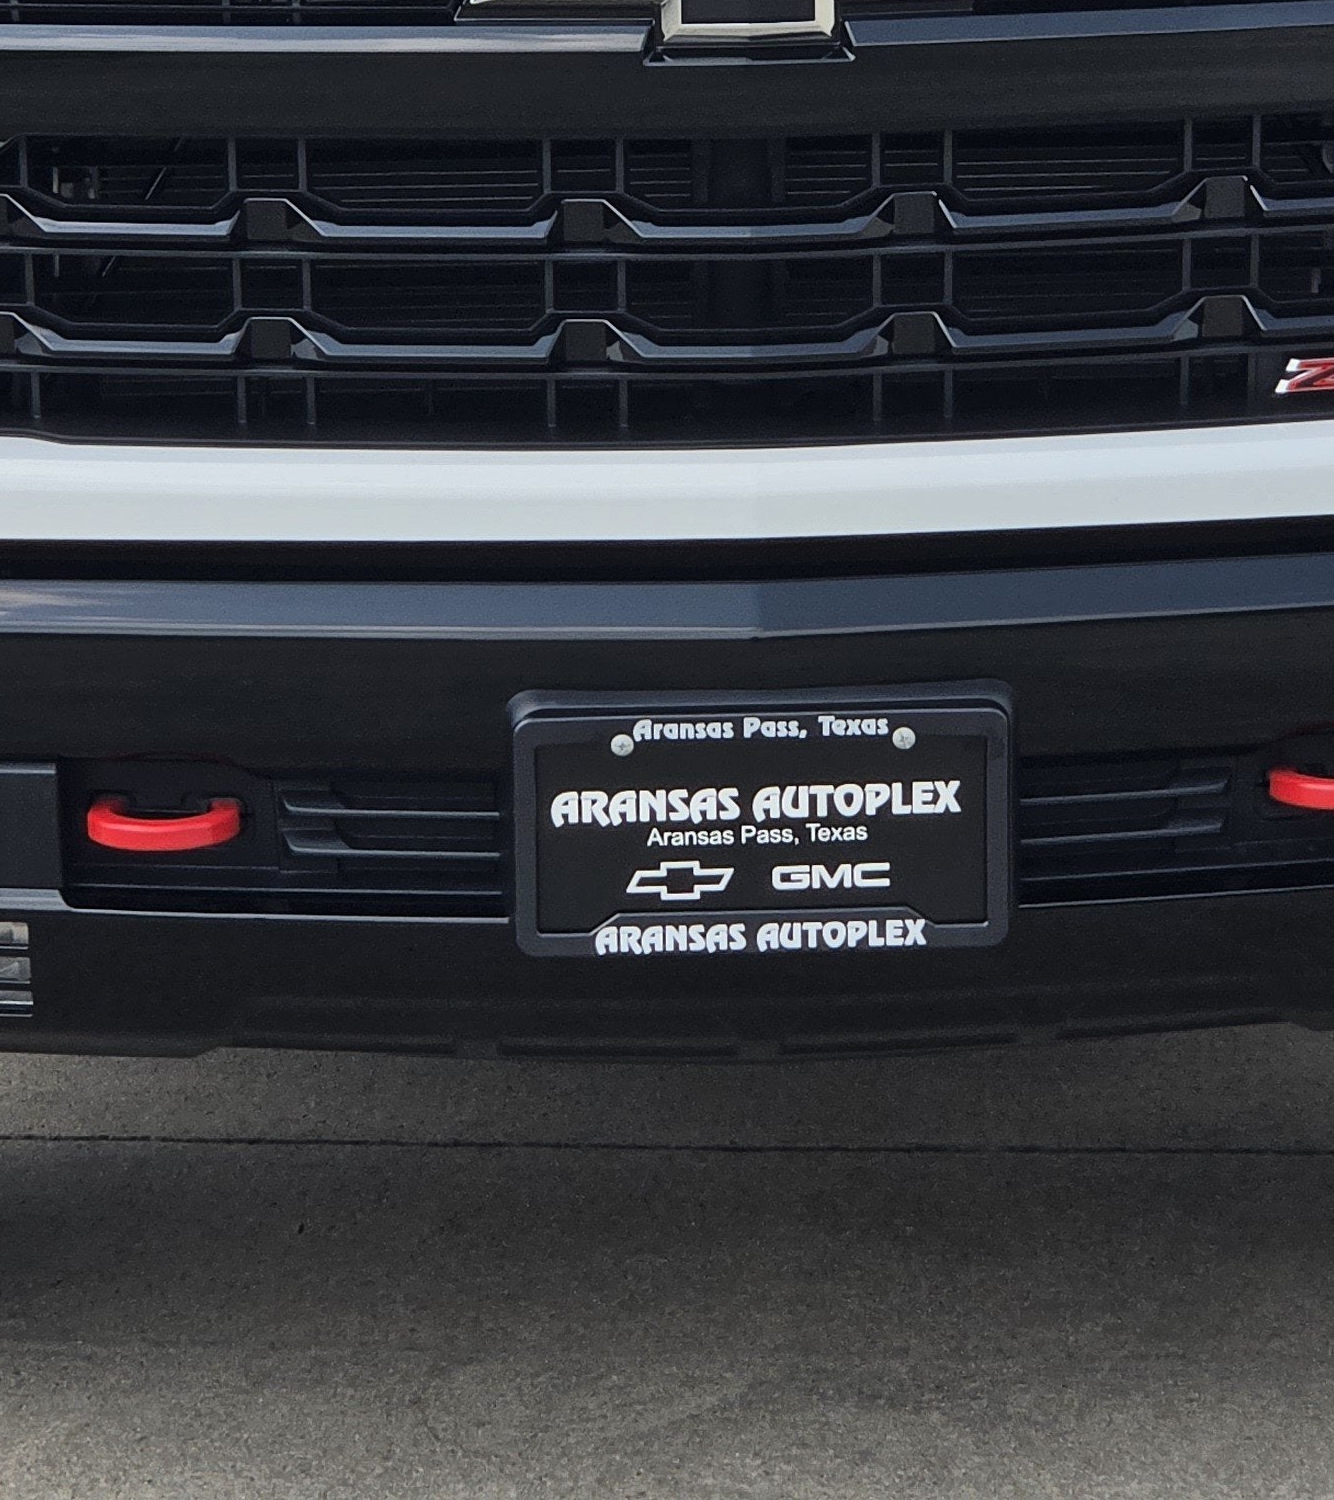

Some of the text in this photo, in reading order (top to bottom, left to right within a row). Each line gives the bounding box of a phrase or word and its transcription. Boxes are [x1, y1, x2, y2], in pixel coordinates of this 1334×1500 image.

[633, 715, 889, 742] Aransas Pass, Texas
[551, 780, 962, 828] ARANSAS AUTOPLEX
[646, 822, 869, 847] Aransas Pass, Texas
[771, 861, 891, 891] GMC
[595, 918, 927, 956] ARANSAS AUTOPLEX
